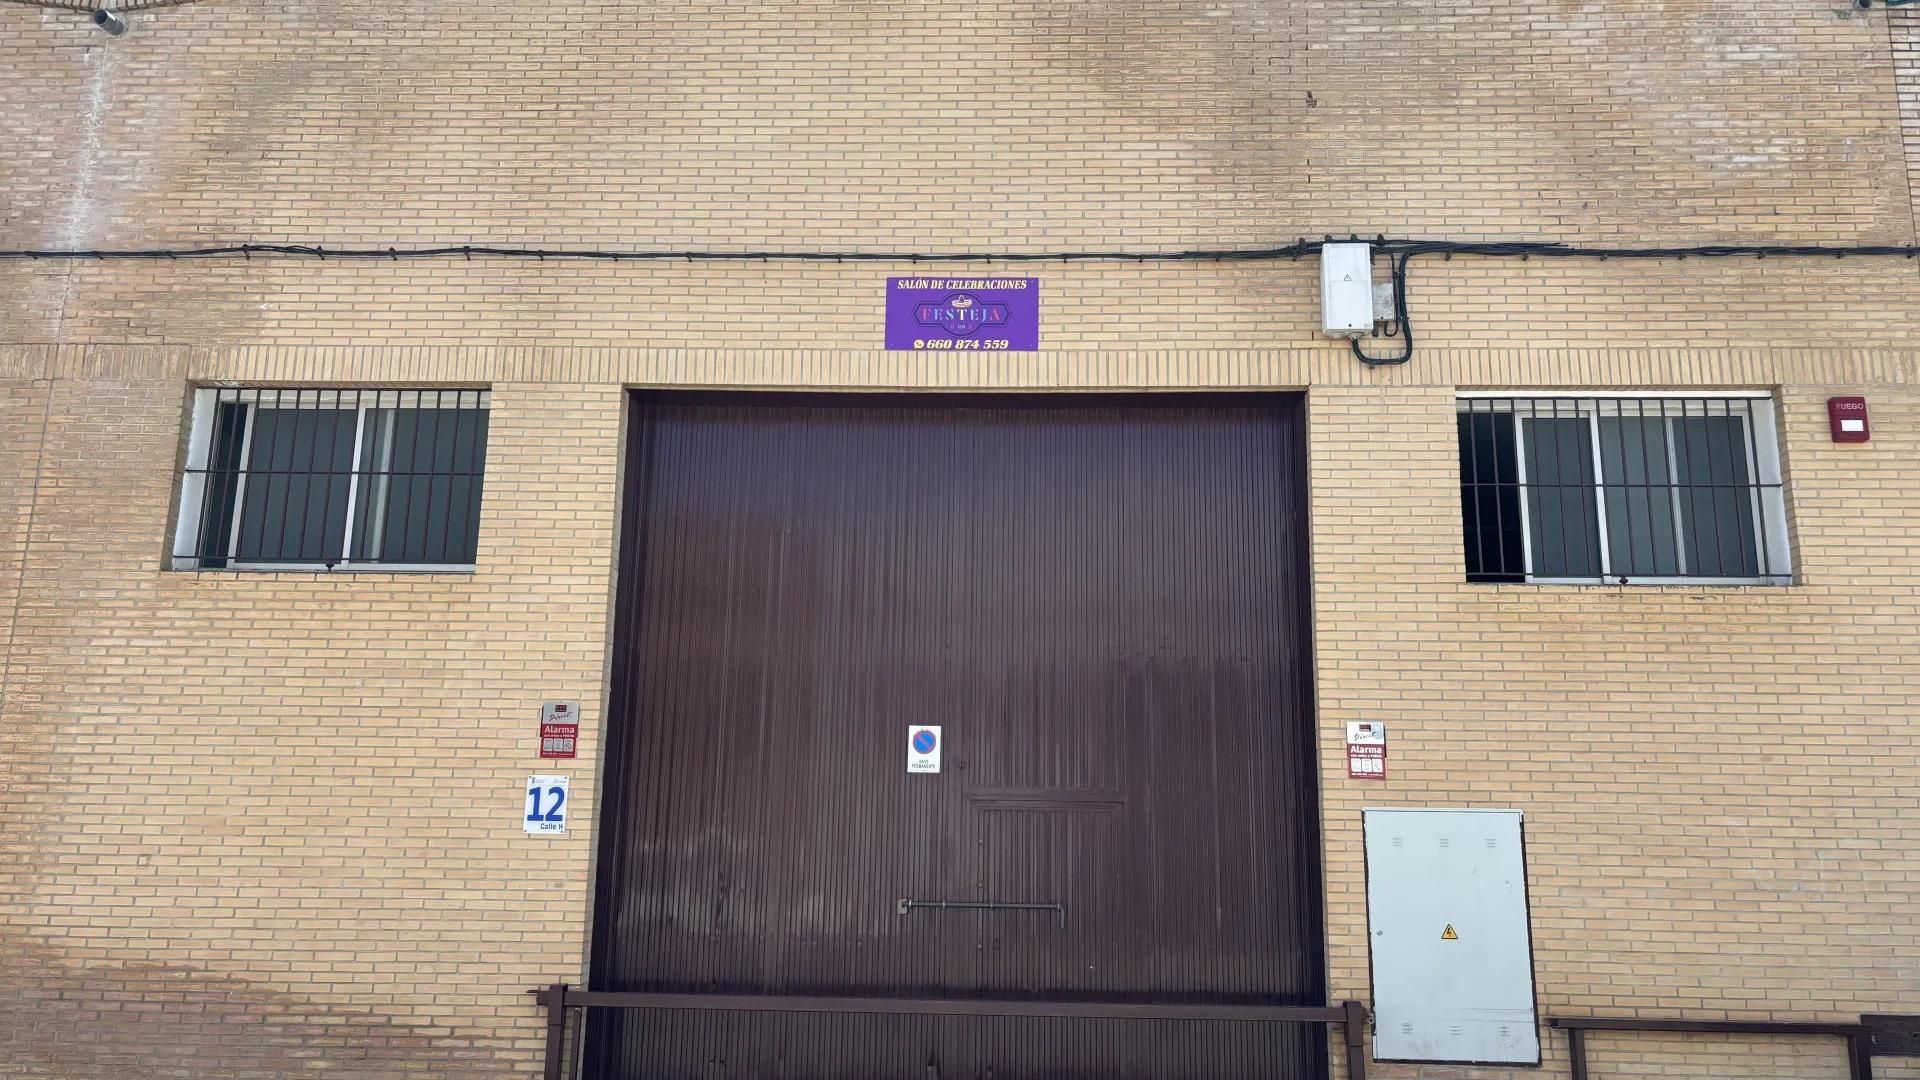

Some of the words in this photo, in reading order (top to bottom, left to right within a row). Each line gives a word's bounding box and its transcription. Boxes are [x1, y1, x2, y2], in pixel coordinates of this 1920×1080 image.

[897, 278, 931, 289] SALÓN
[930, 280, 944, 289] DE
[946, 279, 1028, 290] CELEBRACIONES
[922, 308, 1001, 321] FESTEJA
[927, 339, 952, 349] 660
[955, 339, 980, 349] 874
[983, 339, 1009, 349] 559
[544, 725, 575, 733] Alarma
[1350, 745, 1382, 753] Alarma
[527, 786, 565, 821] 12
